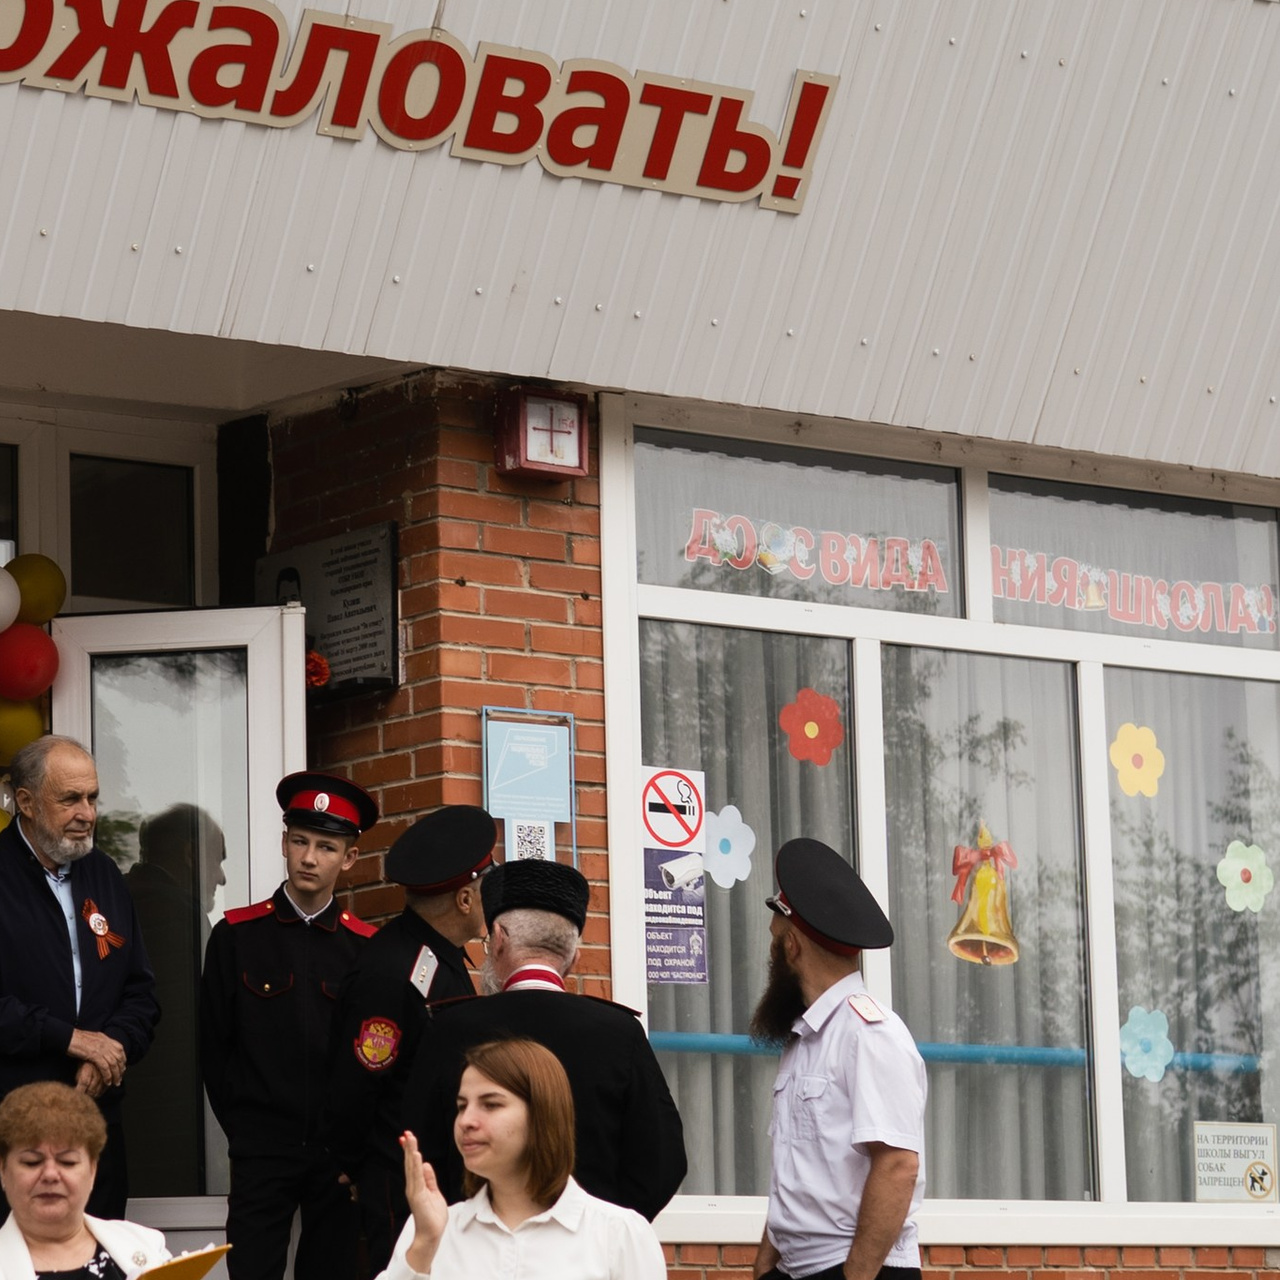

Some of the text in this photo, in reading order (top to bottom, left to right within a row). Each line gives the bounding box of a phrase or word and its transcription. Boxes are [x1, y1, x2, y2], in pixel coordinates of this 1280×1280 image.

[646, 931, 673, 940] ОБЪЕКТ
[647, 945, 686, 954] НАХОДИТСЯ
[647, 958, 662, 967] ПОД
[1196, 1134, 1269, 1146] НА ТЕРРИТОРИИ
[1197, 1148, 1265, 1159] ШКОЛЫ ВЫГУЛ
[1197, 1162, 1226, 1172] СОБАК
